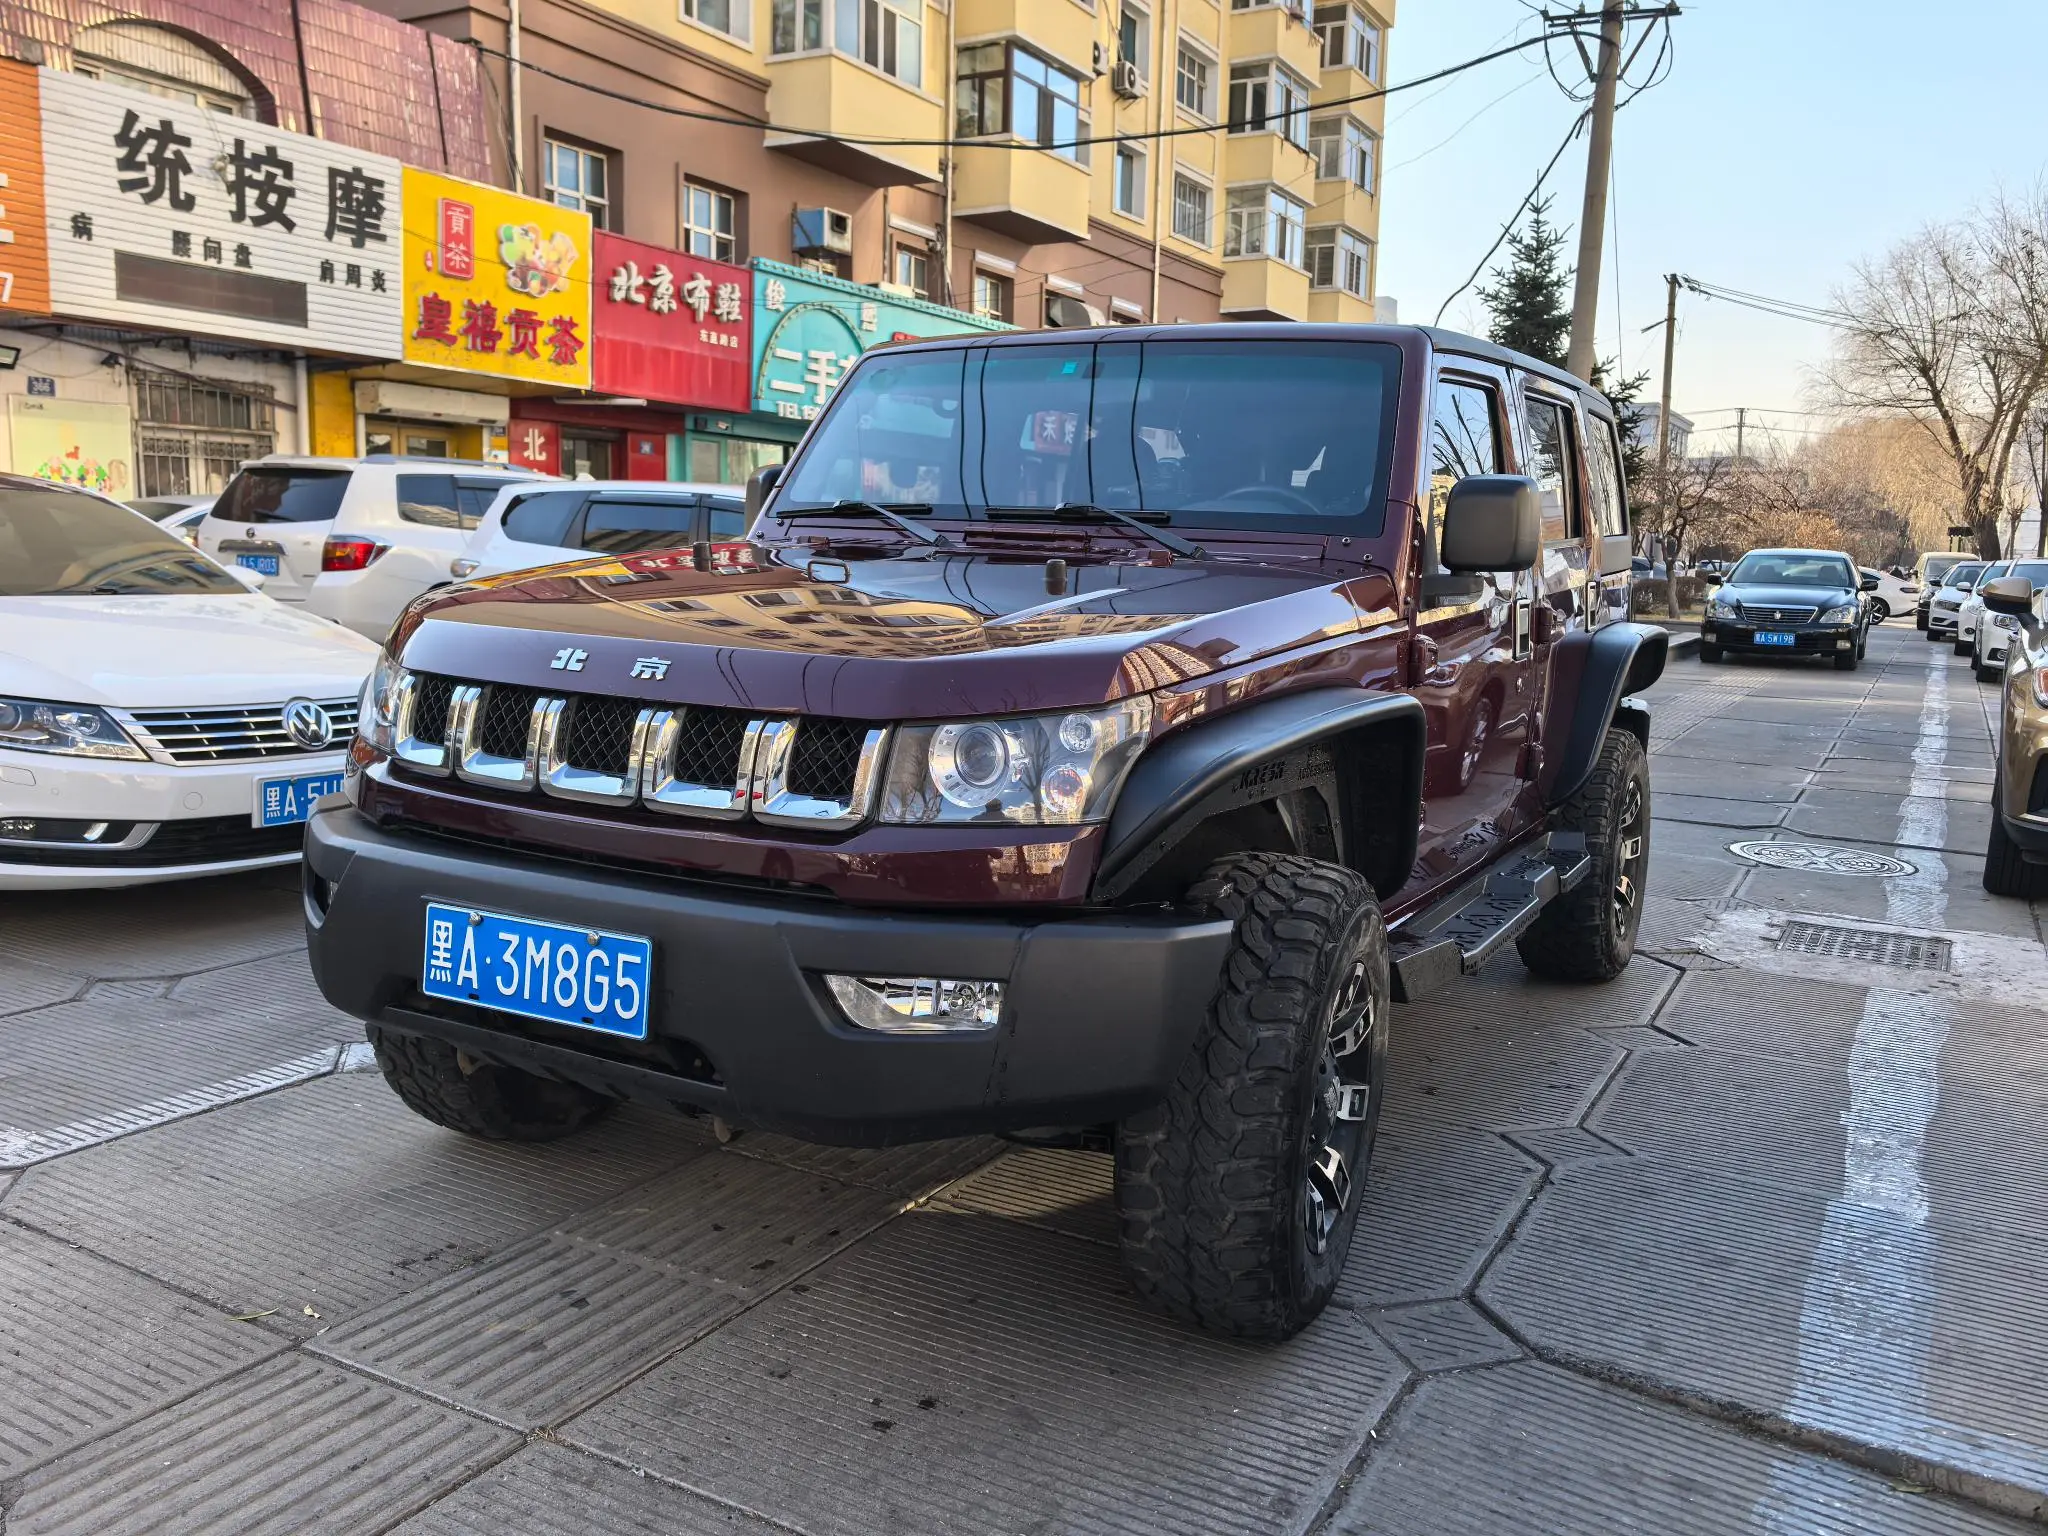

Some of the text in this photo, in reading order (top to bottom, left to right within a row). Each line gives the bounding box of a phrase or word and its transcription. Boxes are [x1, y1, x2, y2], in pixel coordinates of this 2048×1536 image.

[114, 108, 387, 248] 统按摩
[71, 212, 93, 241] 病
[610, 261, 742, 323] 北京布鞋
[413, 293, 584, 365] 皇禧贡茶
[550, 647, 672, 680] 北京
